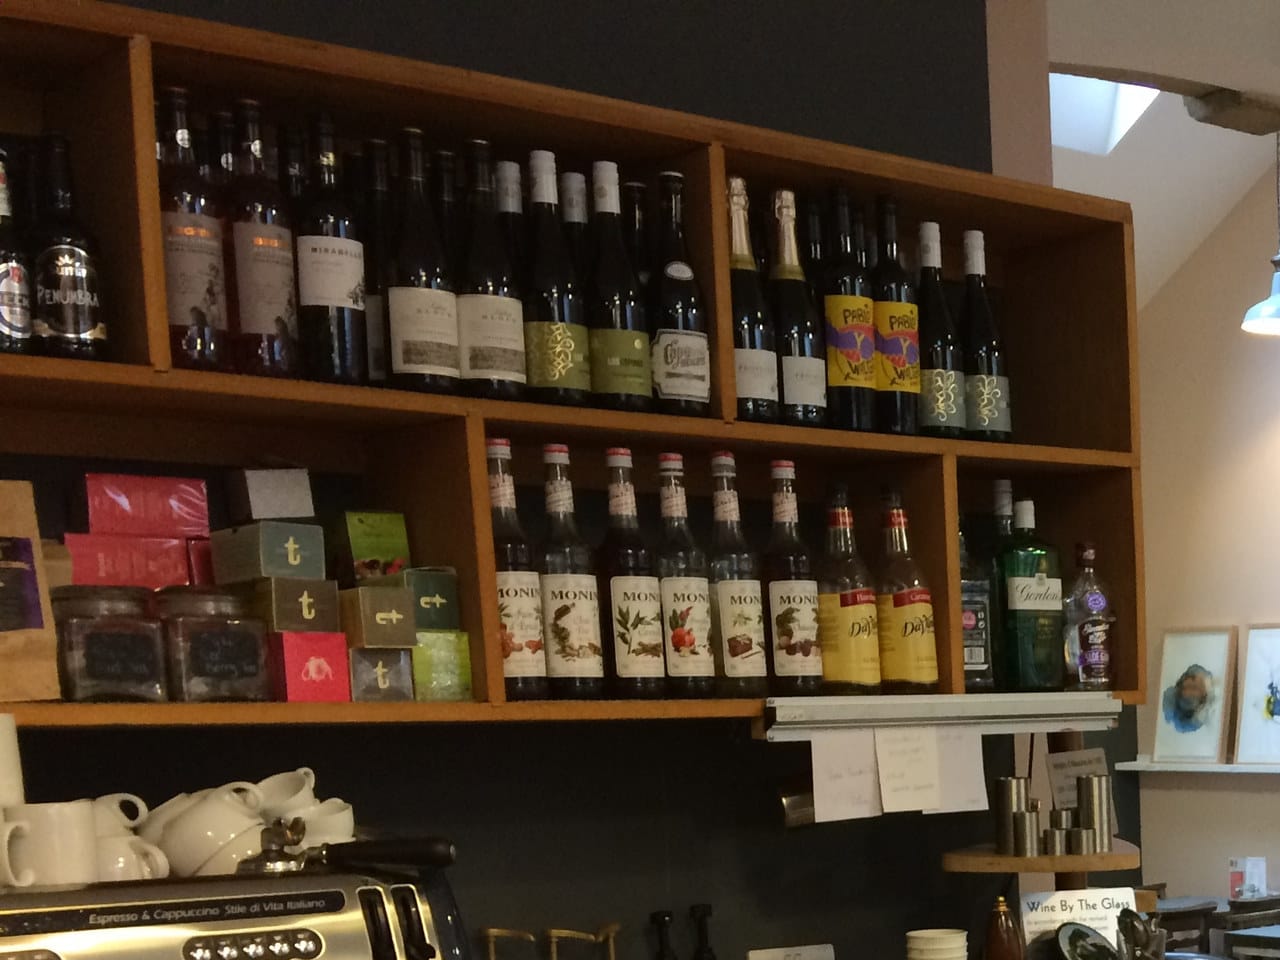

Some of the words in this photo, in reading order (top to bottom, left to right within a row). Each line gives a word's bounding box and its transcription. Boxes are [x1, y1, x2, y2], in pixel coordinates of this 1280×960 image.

[37, 285, 99, 307] PENUMBRA
[88, 913, 138, 925] Espresso
[141, 911, 151, 921] &
[153, 906, 220, 921] Cappuccino
[263, 902, 284, 912] Vita
[286, 899, 326, 910] Italiano
[1027, 901, 1056, 913] Wine
[1060, 900, 1074, 914] By
[1078, 899, 1097, 910] The
[1101, 897, 1130, 910] Glass
